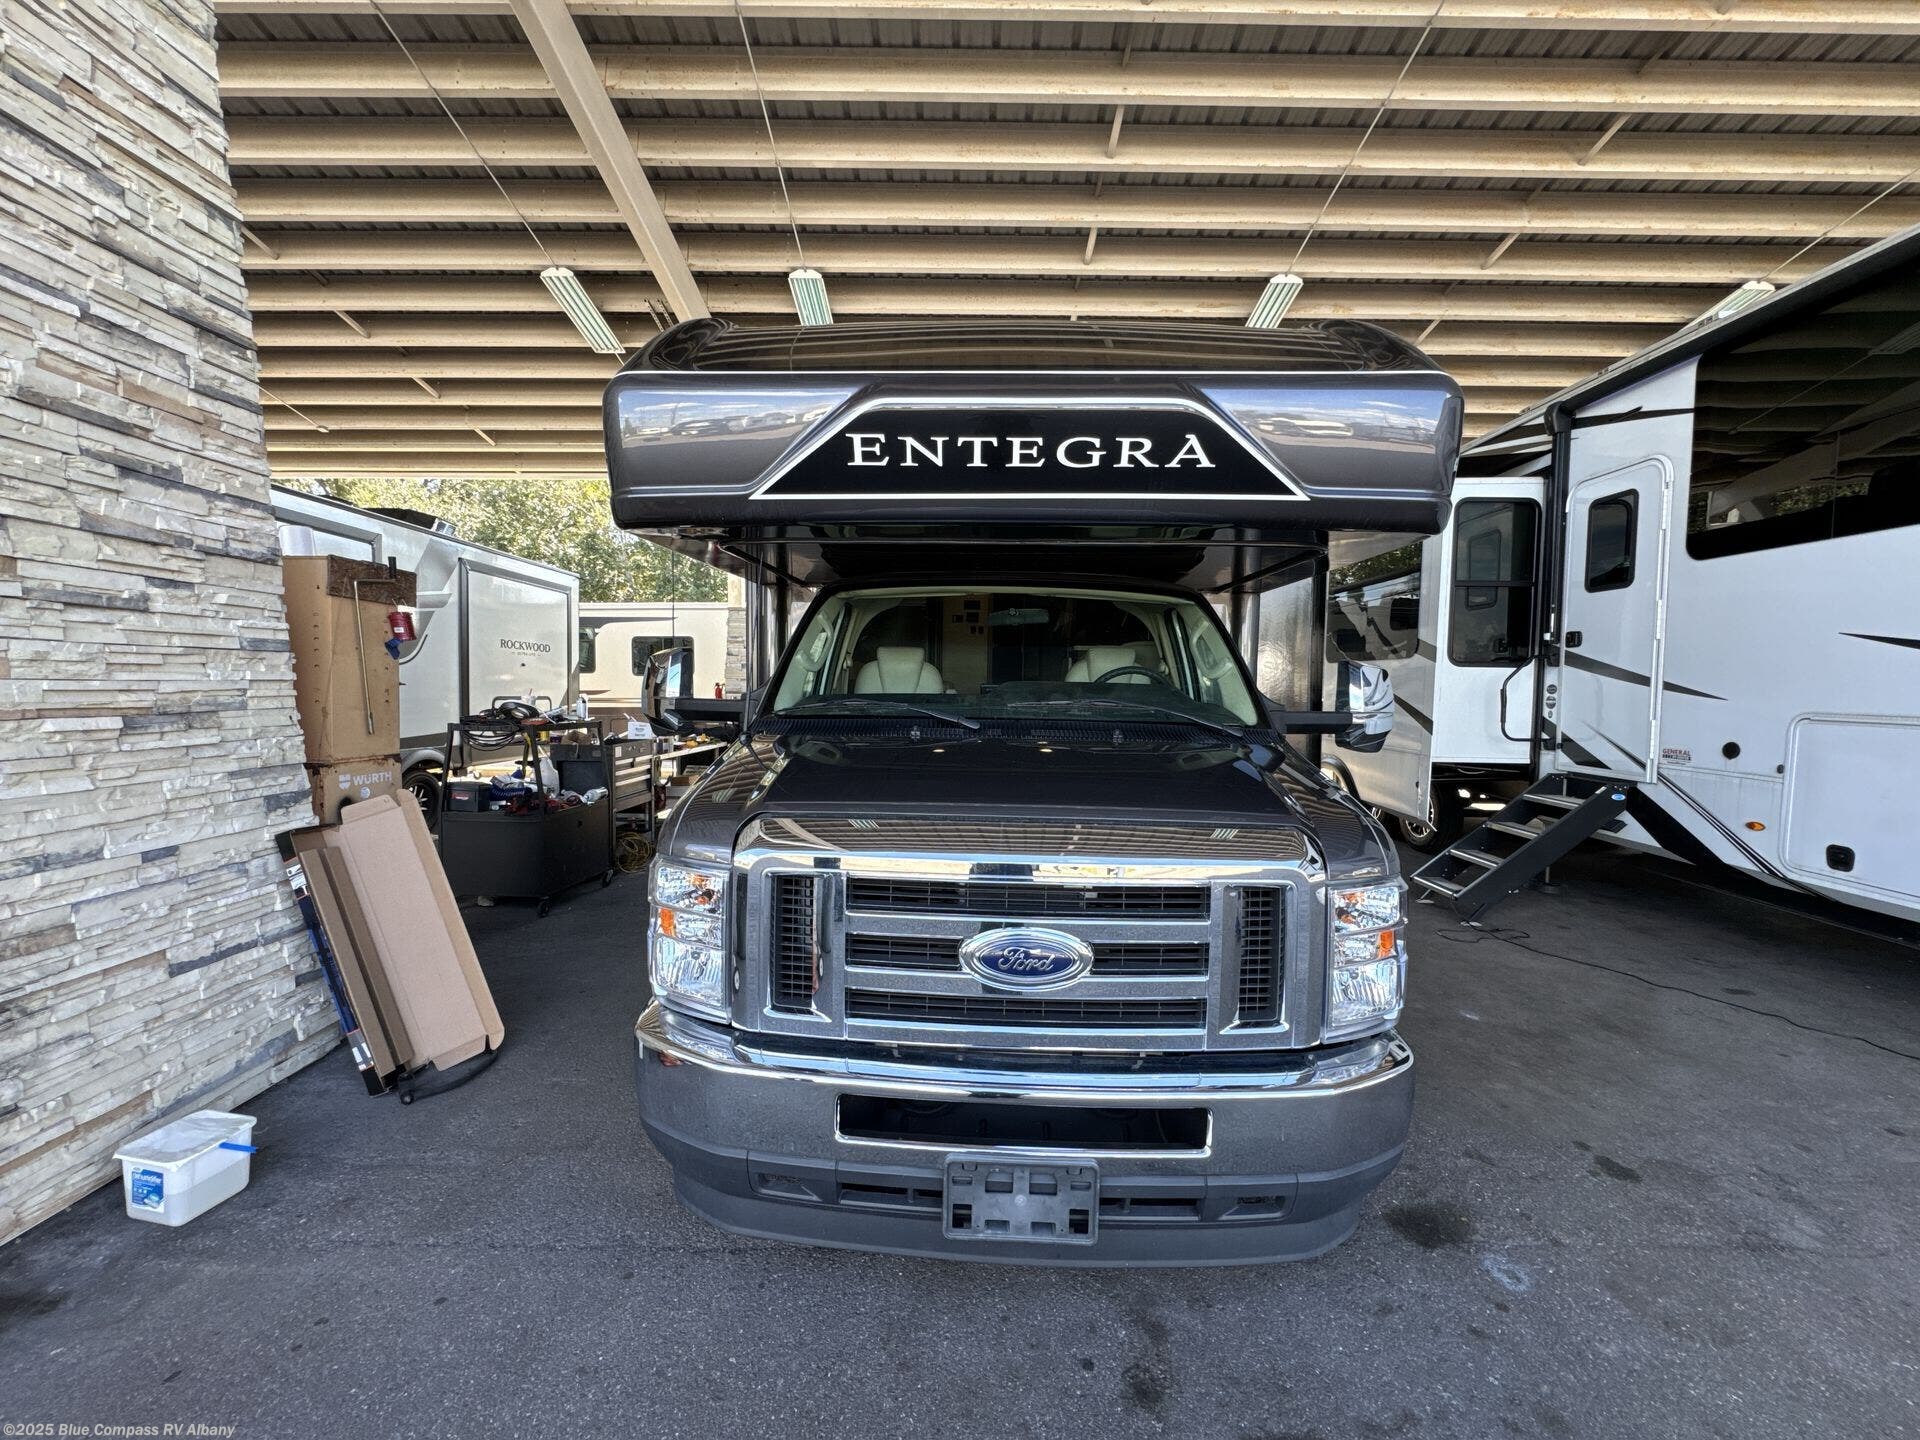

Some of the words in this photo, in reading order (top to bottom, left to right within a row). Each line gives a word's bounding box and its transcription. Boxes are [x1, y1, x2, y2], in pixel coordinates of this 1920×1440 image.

[845, 433, 1216, 469] ENTEGRA
[500, 638, 551, 653] ROCKWOOD
[998, 946, 1056, 971] Ford
